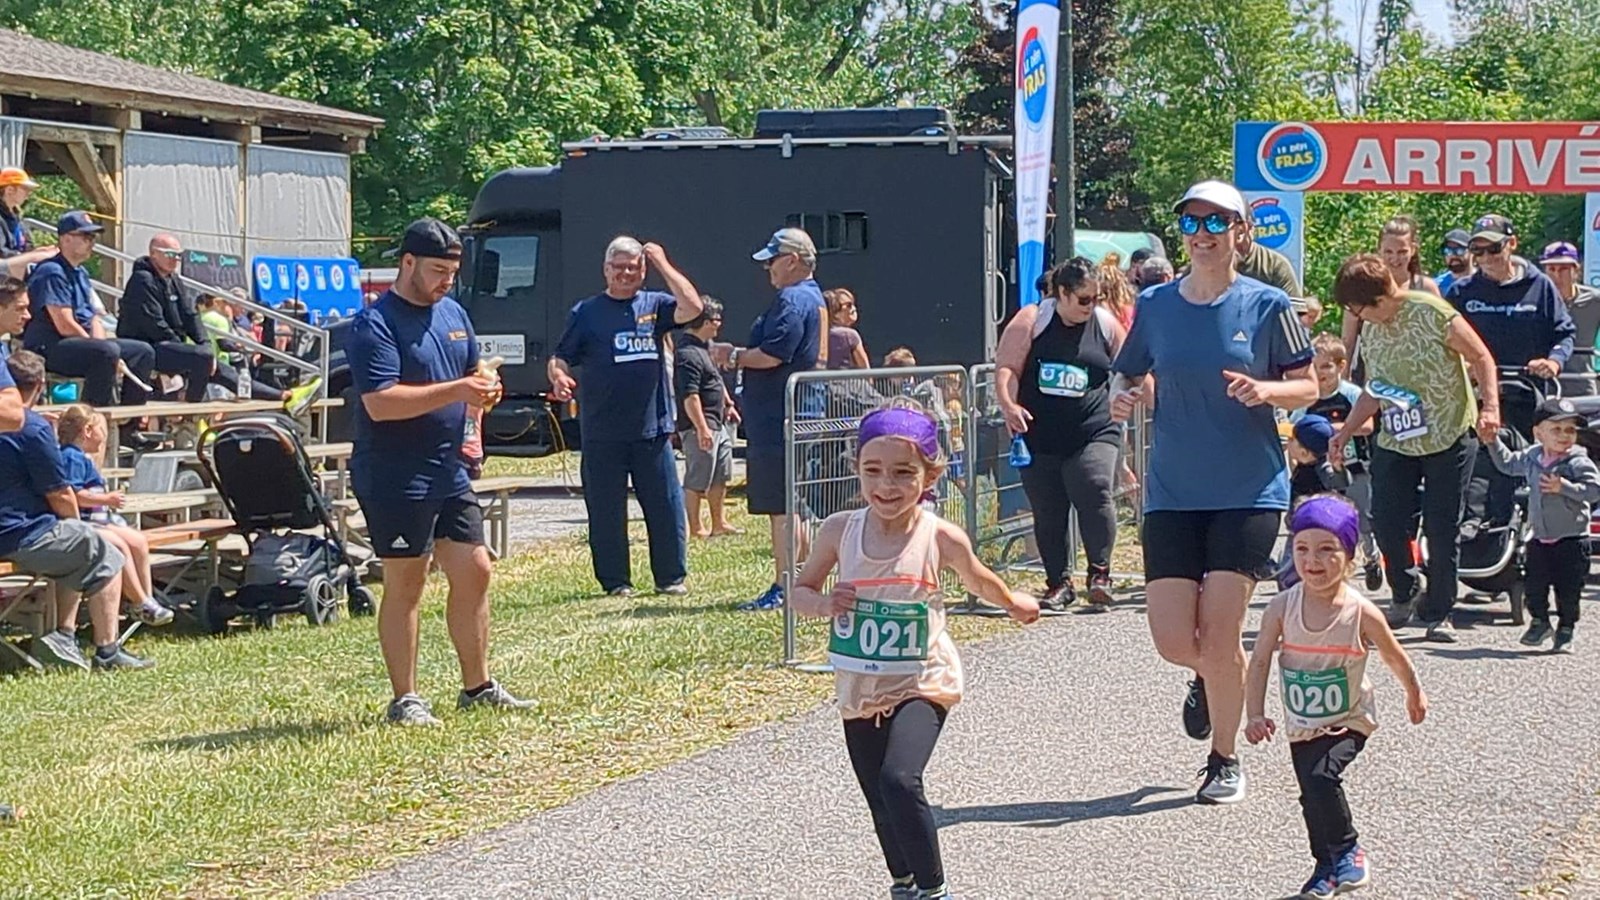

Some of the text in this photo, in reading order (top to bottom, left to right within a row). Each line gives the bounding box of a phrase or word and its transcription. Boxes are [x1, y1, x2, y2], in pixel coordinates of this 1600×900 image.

[1274, 151, 1314, 170] FRAS
[1342, 125, 1600, 186] ARRIVÉ
[1056, 370, 1085, 390] 105
[859, 618, 922, 656] 021
[1289, 683, 1343, 715] 020
